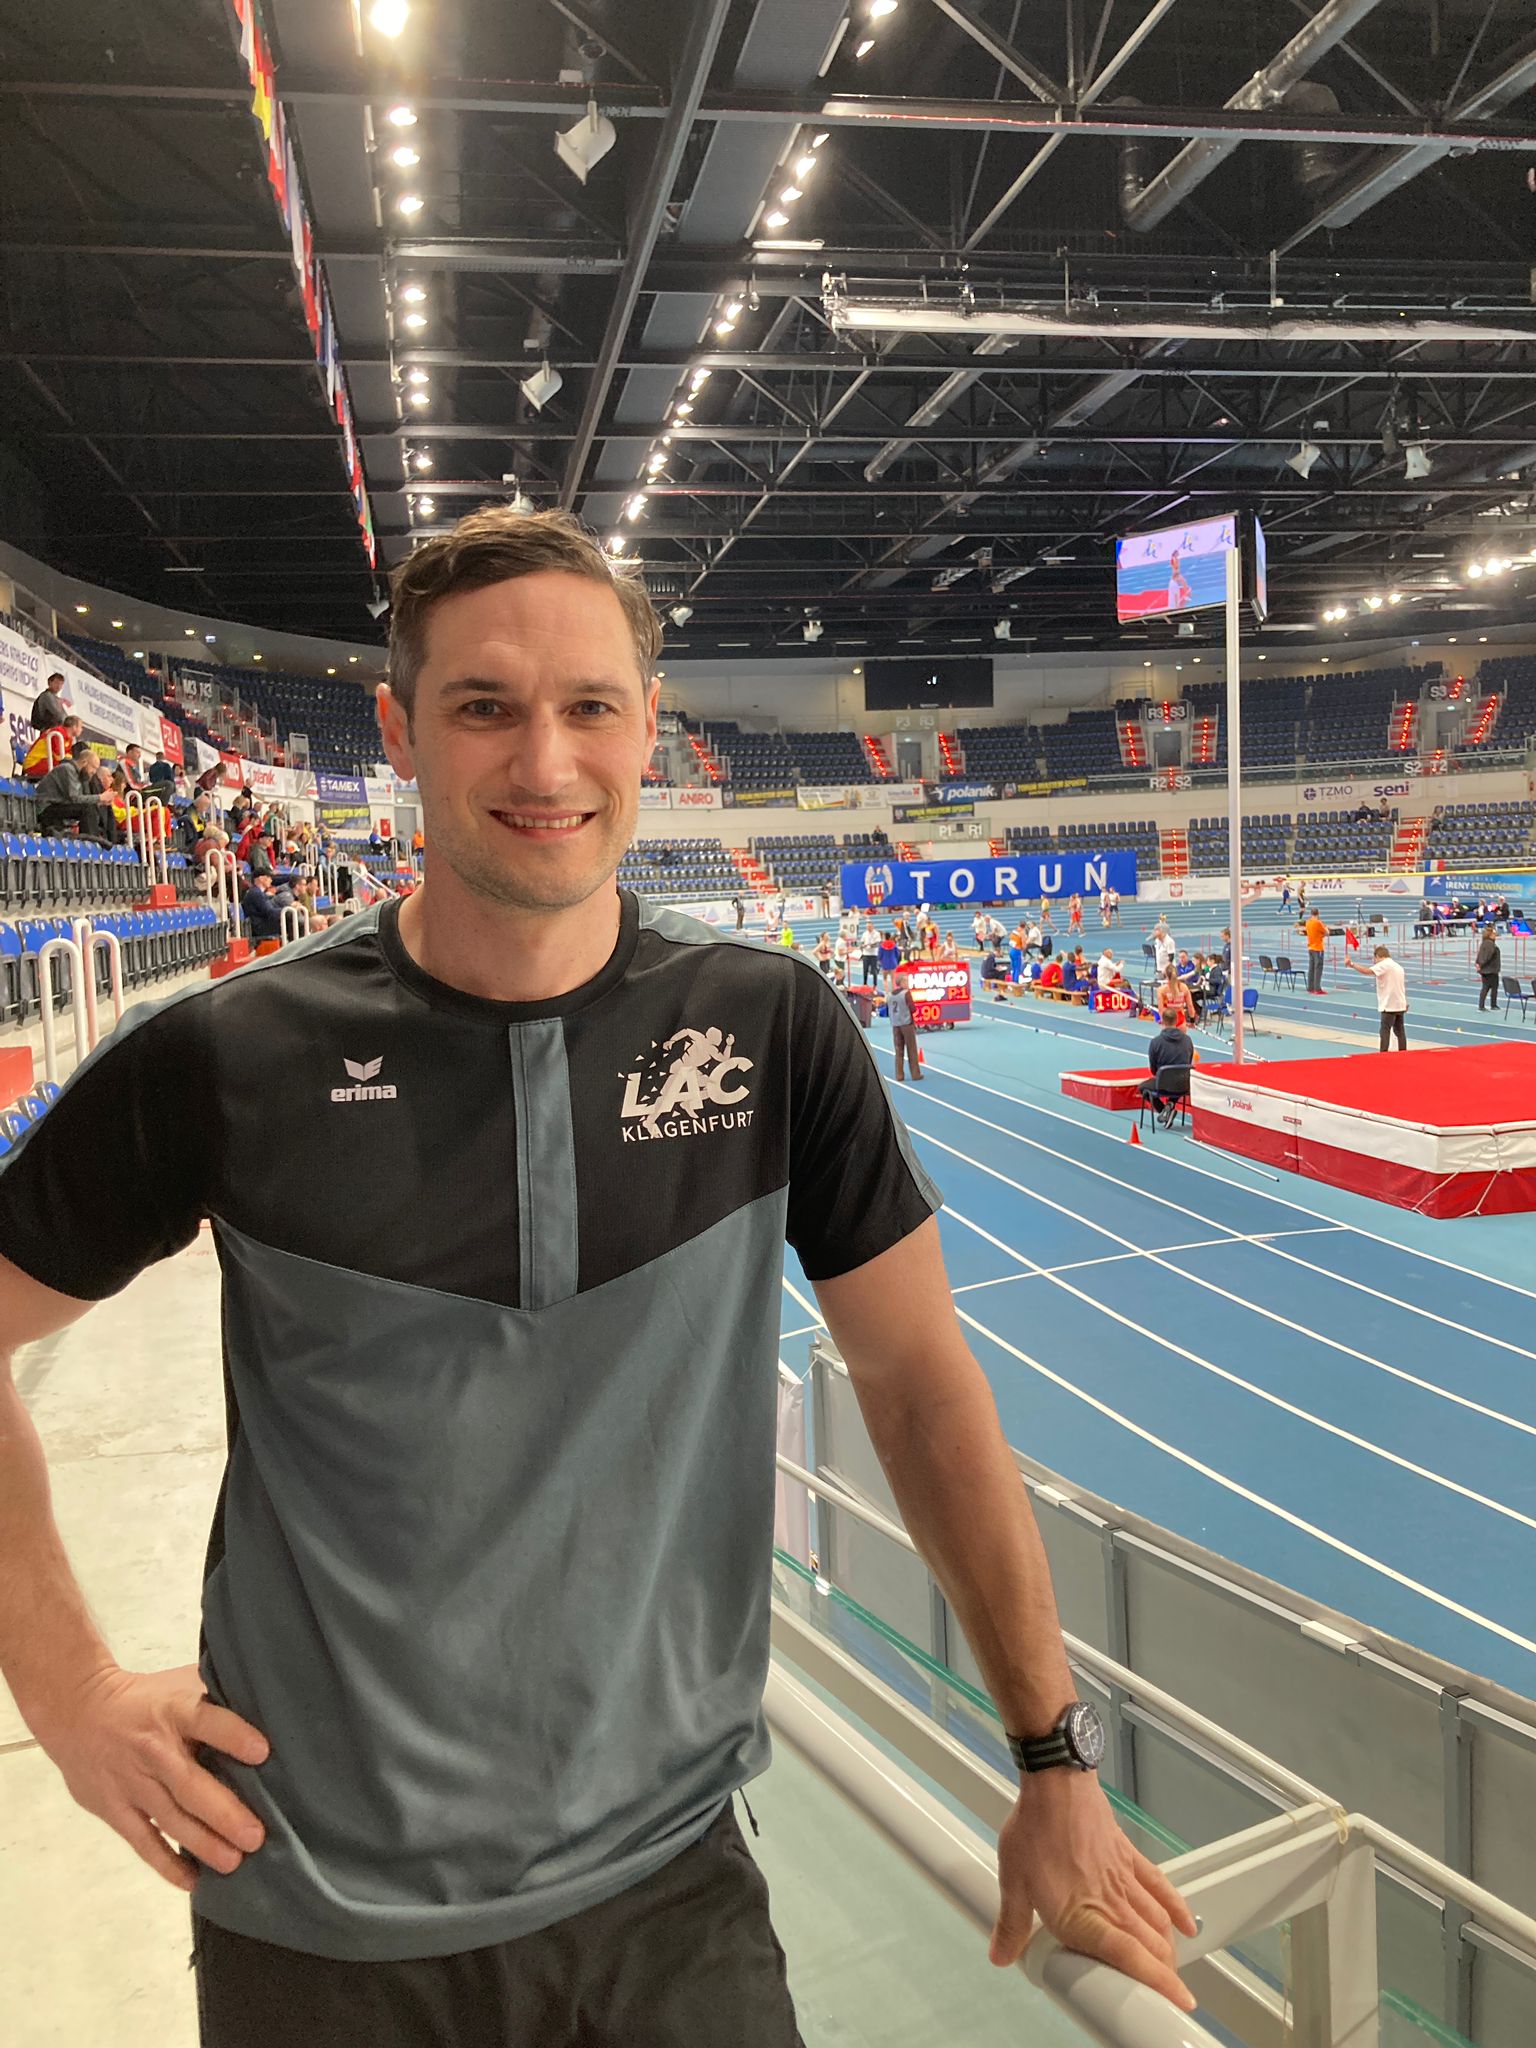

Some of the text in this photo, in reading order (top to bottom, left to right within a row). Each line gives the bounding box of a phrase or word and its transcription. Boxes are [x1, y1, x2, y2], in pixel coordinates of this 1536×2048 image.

[1430, 685, 1447, 697] S3
[1148, 706, 1185, 719] R3 S3
[1404, 760, 1448, 773] S2 T2
[326, 779, 360, 793] TAMEX
[1150, 775, 1192, 789] R2 S2
[1373, 780, 1410, 797] seni
[946, 784, 995, 801] polanik
[1319, 785, 1353, 797] TZMO
[939, 824, 983, 837] P1 R1
[909, 854, 1107, 900] TORUŃ
[1445, 881, 1470, 890] IRENY
[908, 970, 968, 990] HIDALGO
[892, 1000, 899, 1013] 2
[1096, 993, 1129, 1010] 1:00
[330, 1083, 397, 1103] erima
[620, 1056, 755, 1118] LAC
[621, 1109, 755, 1143] KLAGENFURT
